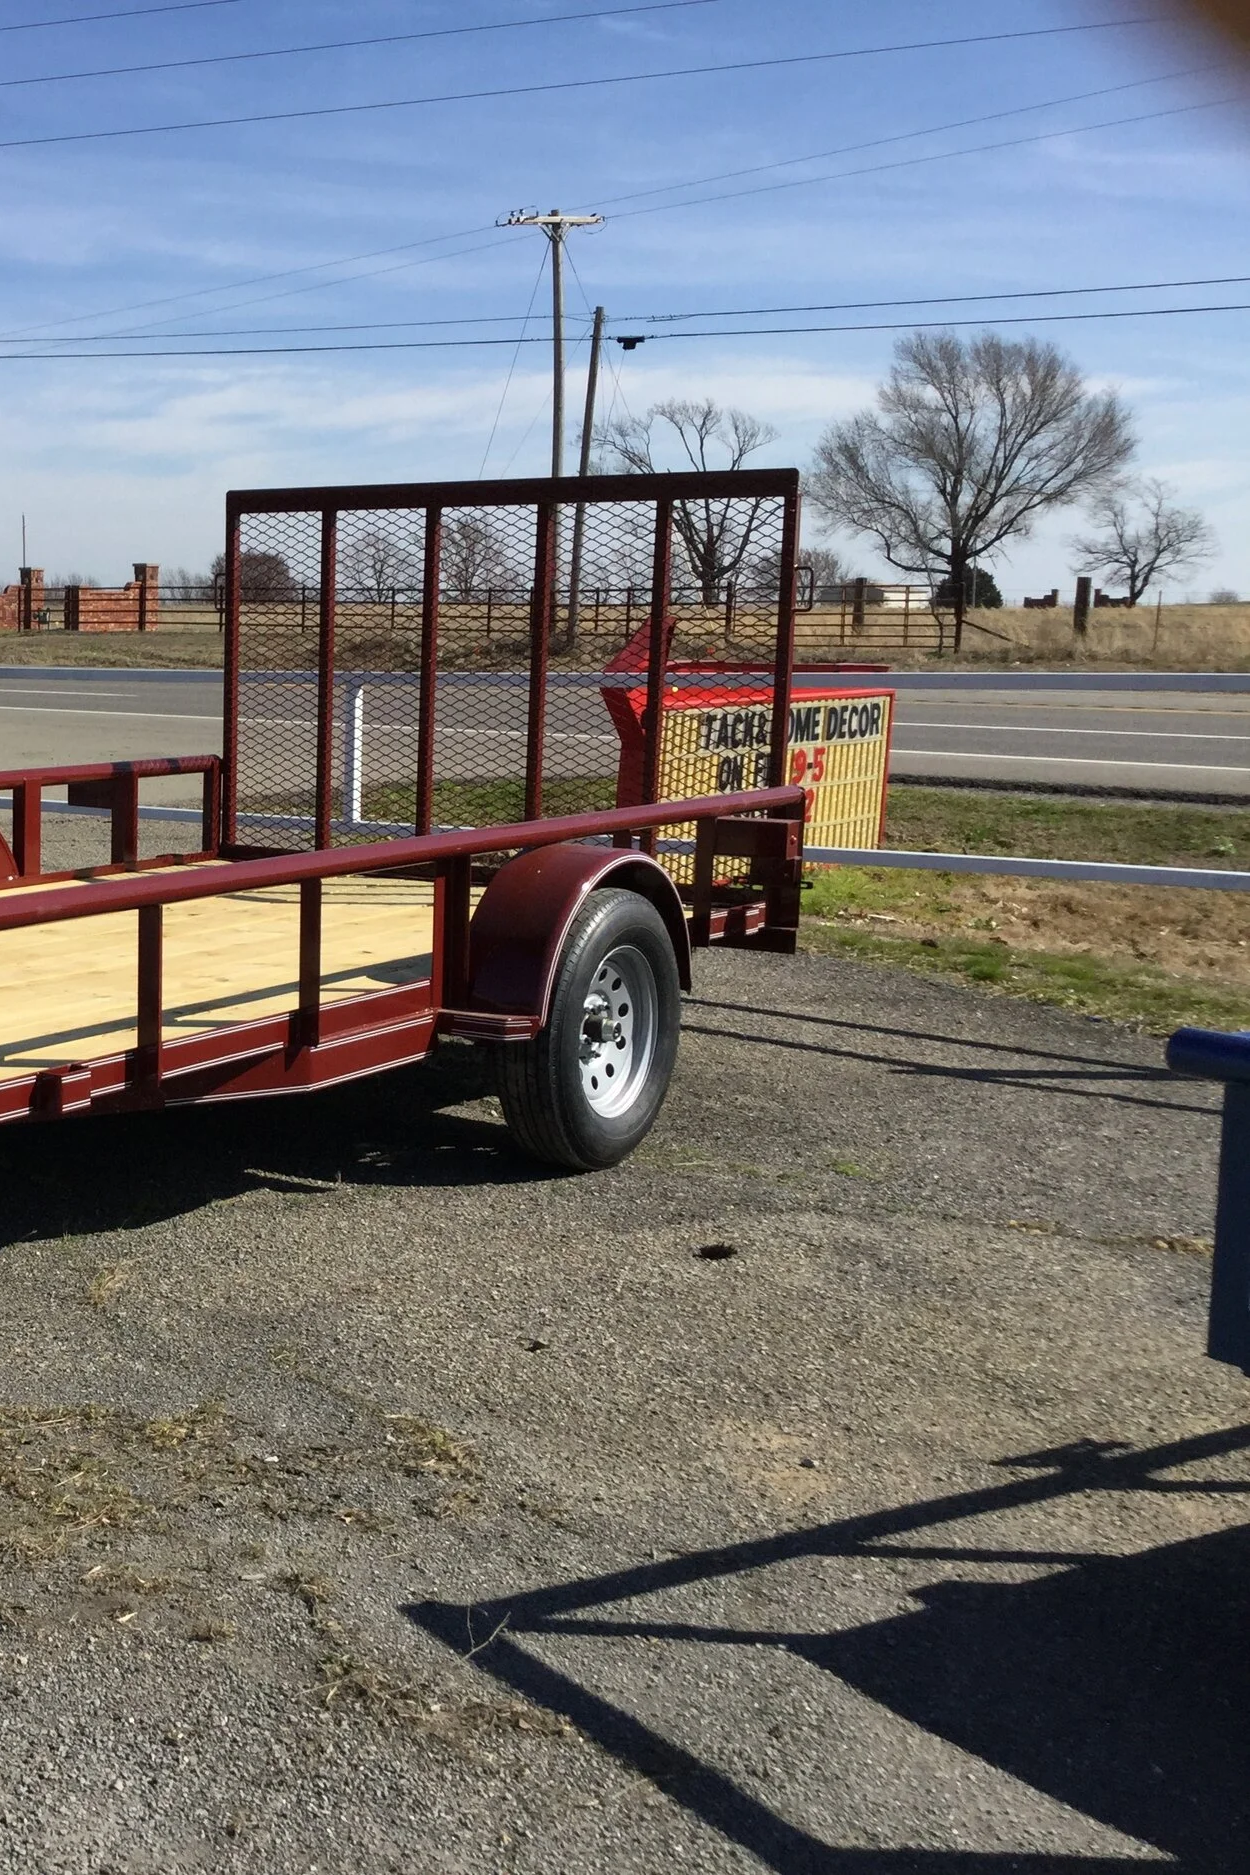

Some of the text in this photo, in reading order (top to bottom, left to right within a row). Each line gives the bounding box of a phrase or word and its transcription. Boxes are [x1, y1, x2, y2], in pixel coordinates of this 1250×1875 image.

[787, 707, 821, 743] OME
[826, 702, 882, 741] DECOR
[791, 747, 827, 785] 9-5
